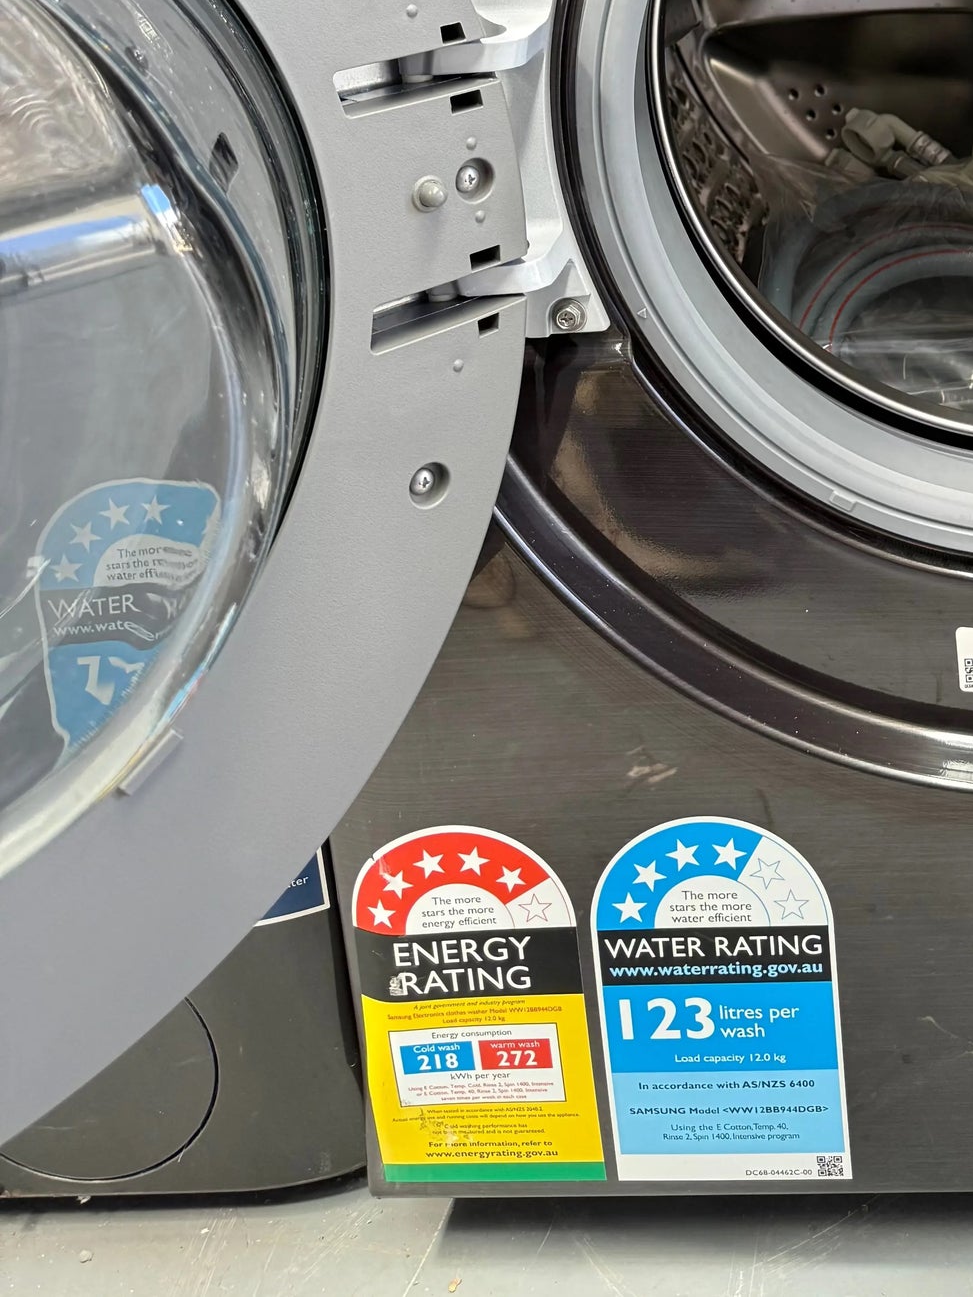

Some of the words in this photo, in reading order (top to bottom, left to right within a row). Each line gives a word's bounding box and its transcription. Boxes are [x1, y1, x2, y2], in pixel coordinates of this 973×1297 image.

[48, 593, 142, 619] WATER
[682, 890, 704, 900] The
[707, 891, 738, 900] more
[432, 897, 452, 906] The
[455, 896, 481, 904] more
[422, 909, 445, 918] stars
[448, 907, 464, 916] the
[467, 906, 494, 914] more
[669, 903, 696, 912] stars
[699, 902, 719, 912] the
[722, 902, 752, 911] more
[422, 919, 455, 929] energy
[458, 917, 497, 926] efficient
[671, 915, 705, 923] water
[708, 913, 752, 922] efficient
[393, 936, 531, 967] ENERGY
[604, 936, 705, 959] WATER
[714, 934, 823, 957] RATING
[609, 961, 823, 978] www.waterrating.gov.au
[400, 966, 532, 996] RATING
[618, 997, 715, 1040] 123
[719, 1004, 763, 1020] litres
[770, 1006, 799, 1023] per
[431, 1032, 459, 1040] Energy
[461, 1029, 512, 1038] consumption
[720, 1023, 765, 1038] wash
[413, 1045, 436, 1053] Cold
[437, 1043, 461, 1051] wash
[490, 1041, 516, 1050] warm
[518, 1040, 540, 1049] wash
[417, 1053, 459, 1070] 218
[496, 1050, 538, 1067] 272
[674, 1054, 700, 1063] Load
[703, 1054, 744, 1063] capacity
[749, 1053, 770, 1062] 12.0
[773, 1053, 787, 1063] kg
[475, 1072, 490, 1081] per
[492, 1072, 511, 1081] year
[638, 1082, 649, 1091] In
[651, 1081, 713, 1090] accordance
[716, 1080, 740, 1089] with
[742, 1080, 786, 1089] AS/NZS
[789, 1079, 815, 1088] 6400
[629, 1107, 686, 1115] SAMSUNG
[689, 1106, 720, 1115] Model
[722, 1105, 829, 1114] <WW12BB944DGB>
[670, 1123, 696, 1132] Using
[698, 1123, 713, 1131] the
[716, 1123, 722, 1131] E
[663, 1133, 683, 1141] Rinse
[693, 1133, 709, 1142] Spin
[732, 1132, 765, 1140] Intensive
[768, 1132, 801, 1142] program
[469, 1140, 521, 1148] information,
[425, 1149, 559, 1159] www.energyrating.gov.au
